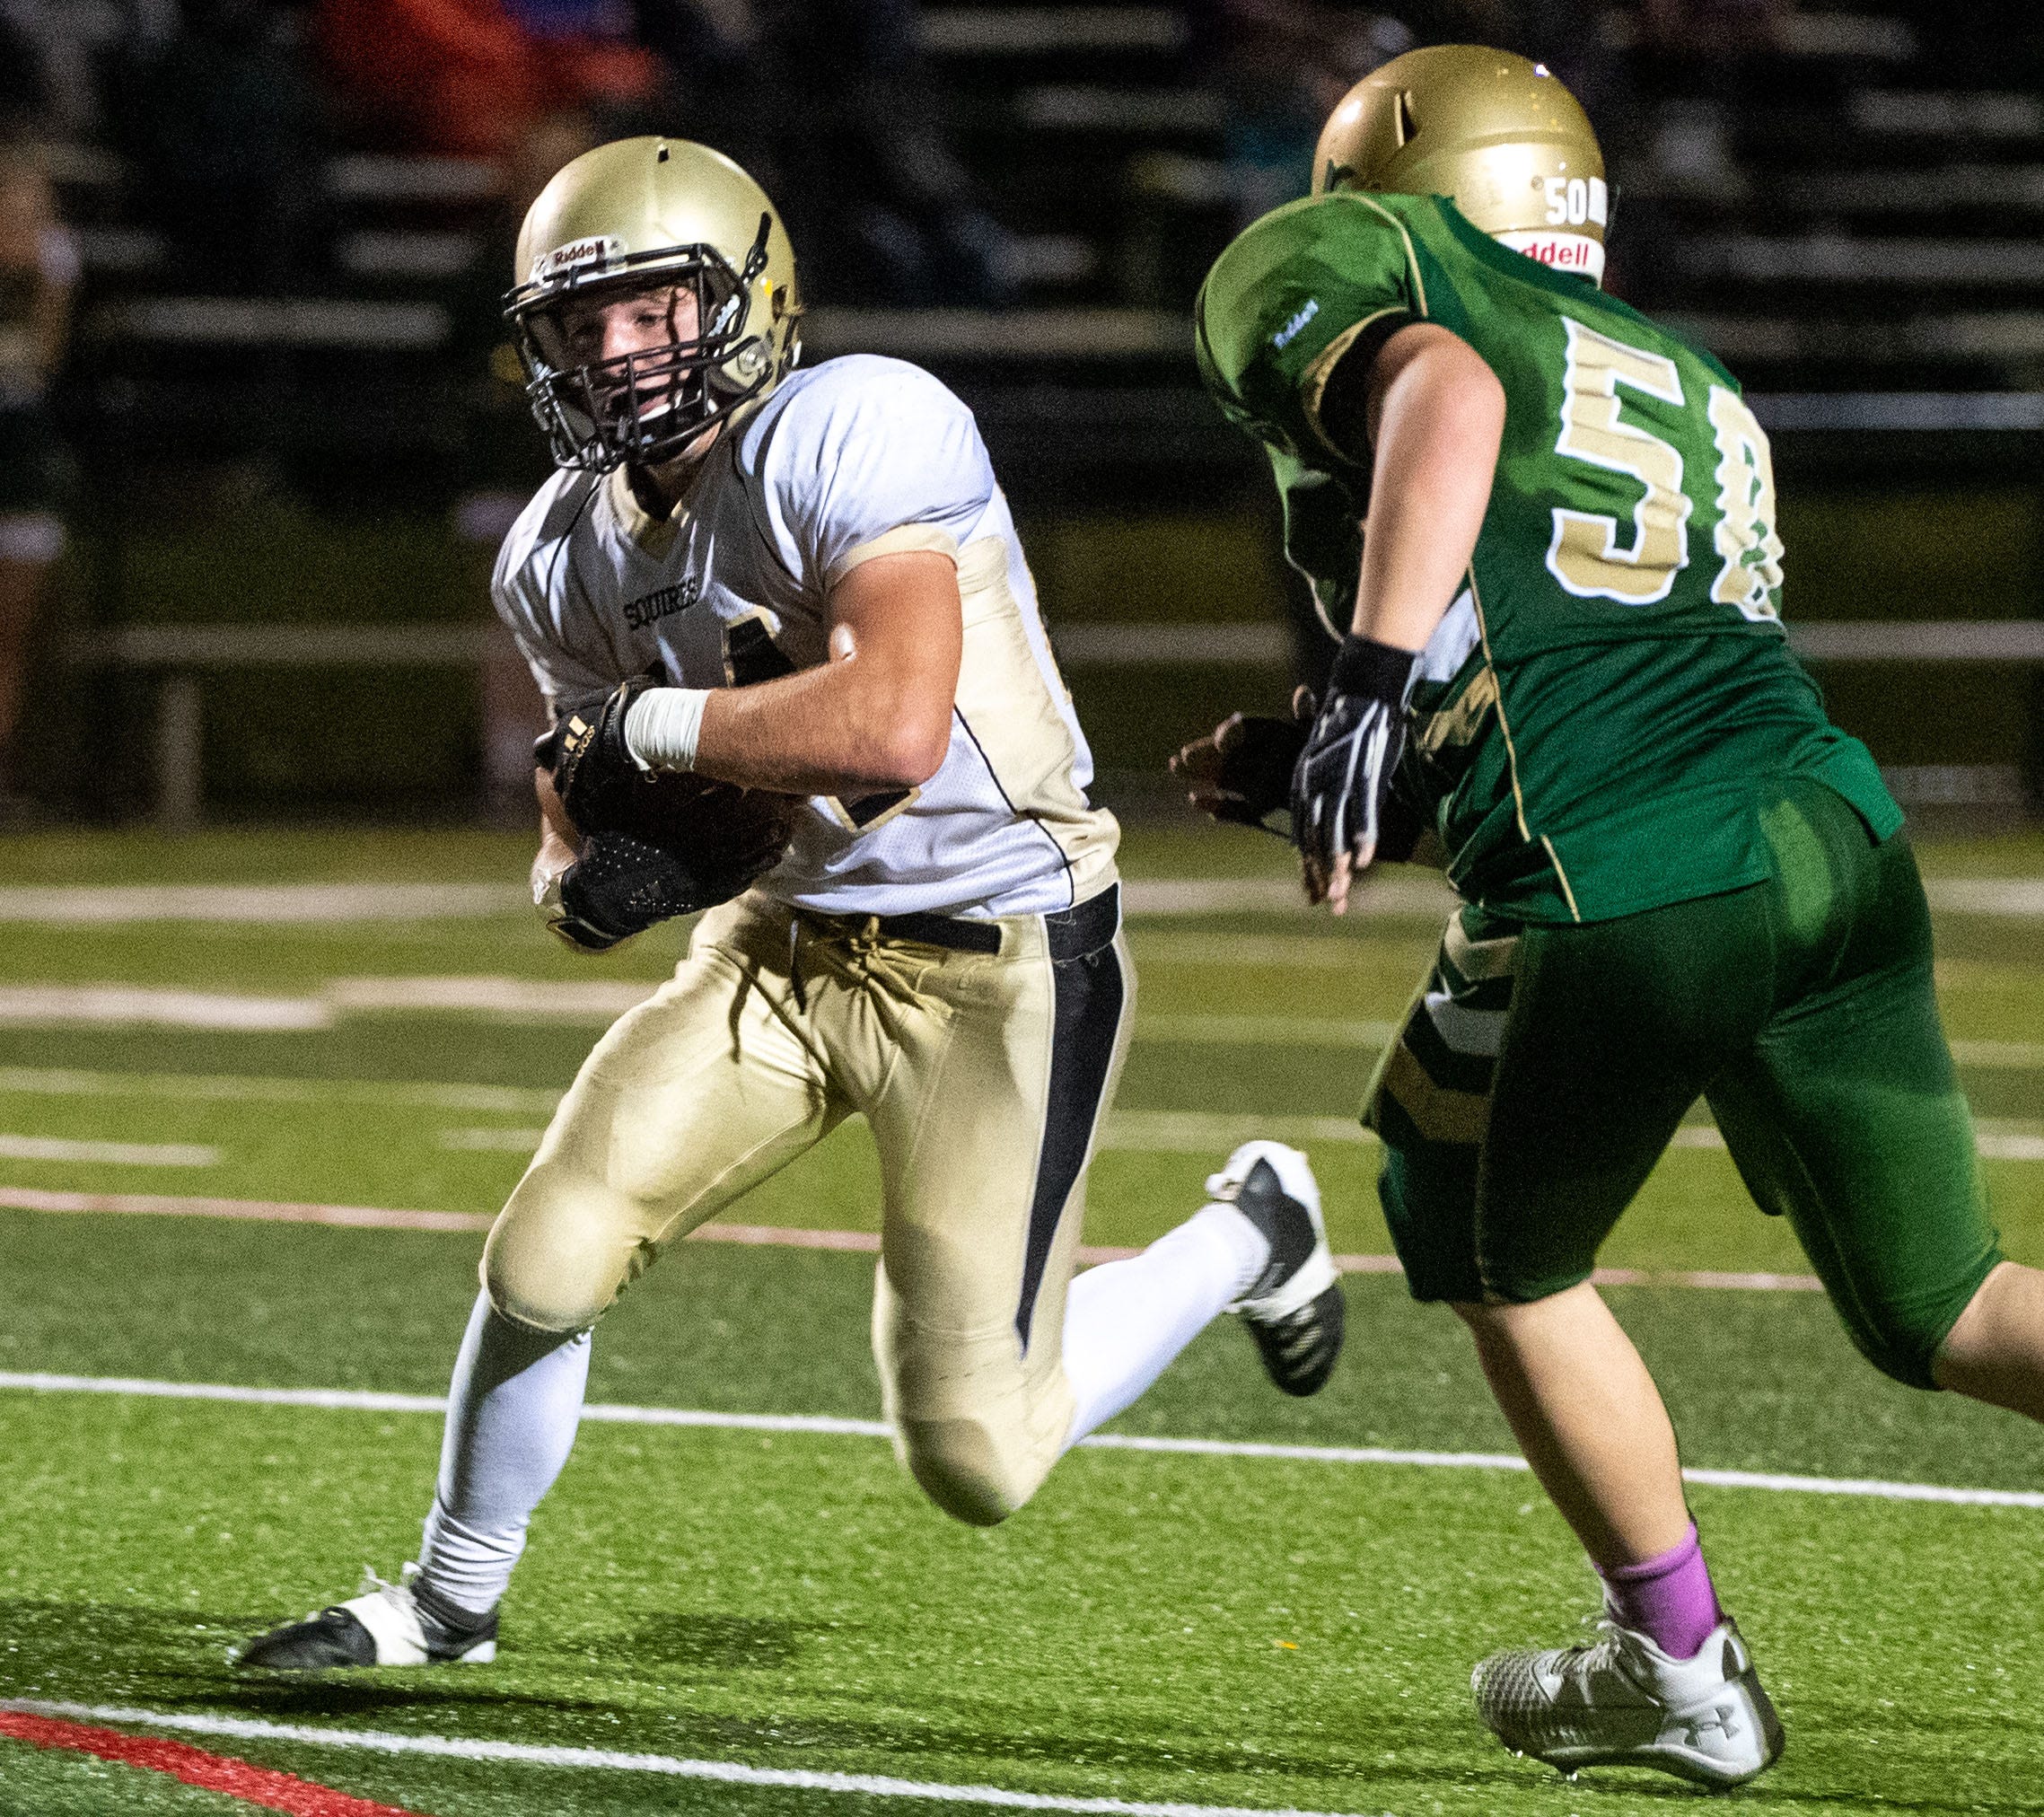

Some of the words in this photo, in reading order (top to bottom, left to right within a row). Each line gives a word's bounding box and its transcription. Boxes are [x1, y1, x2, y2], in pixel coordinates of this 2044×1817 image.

[1544, 177, 1588, 225] 50
[553, 239, 605, 267] Riddell
[1521, 241, 1589, 268] ddell
[623, 575, 698, 630] SQUIRES
